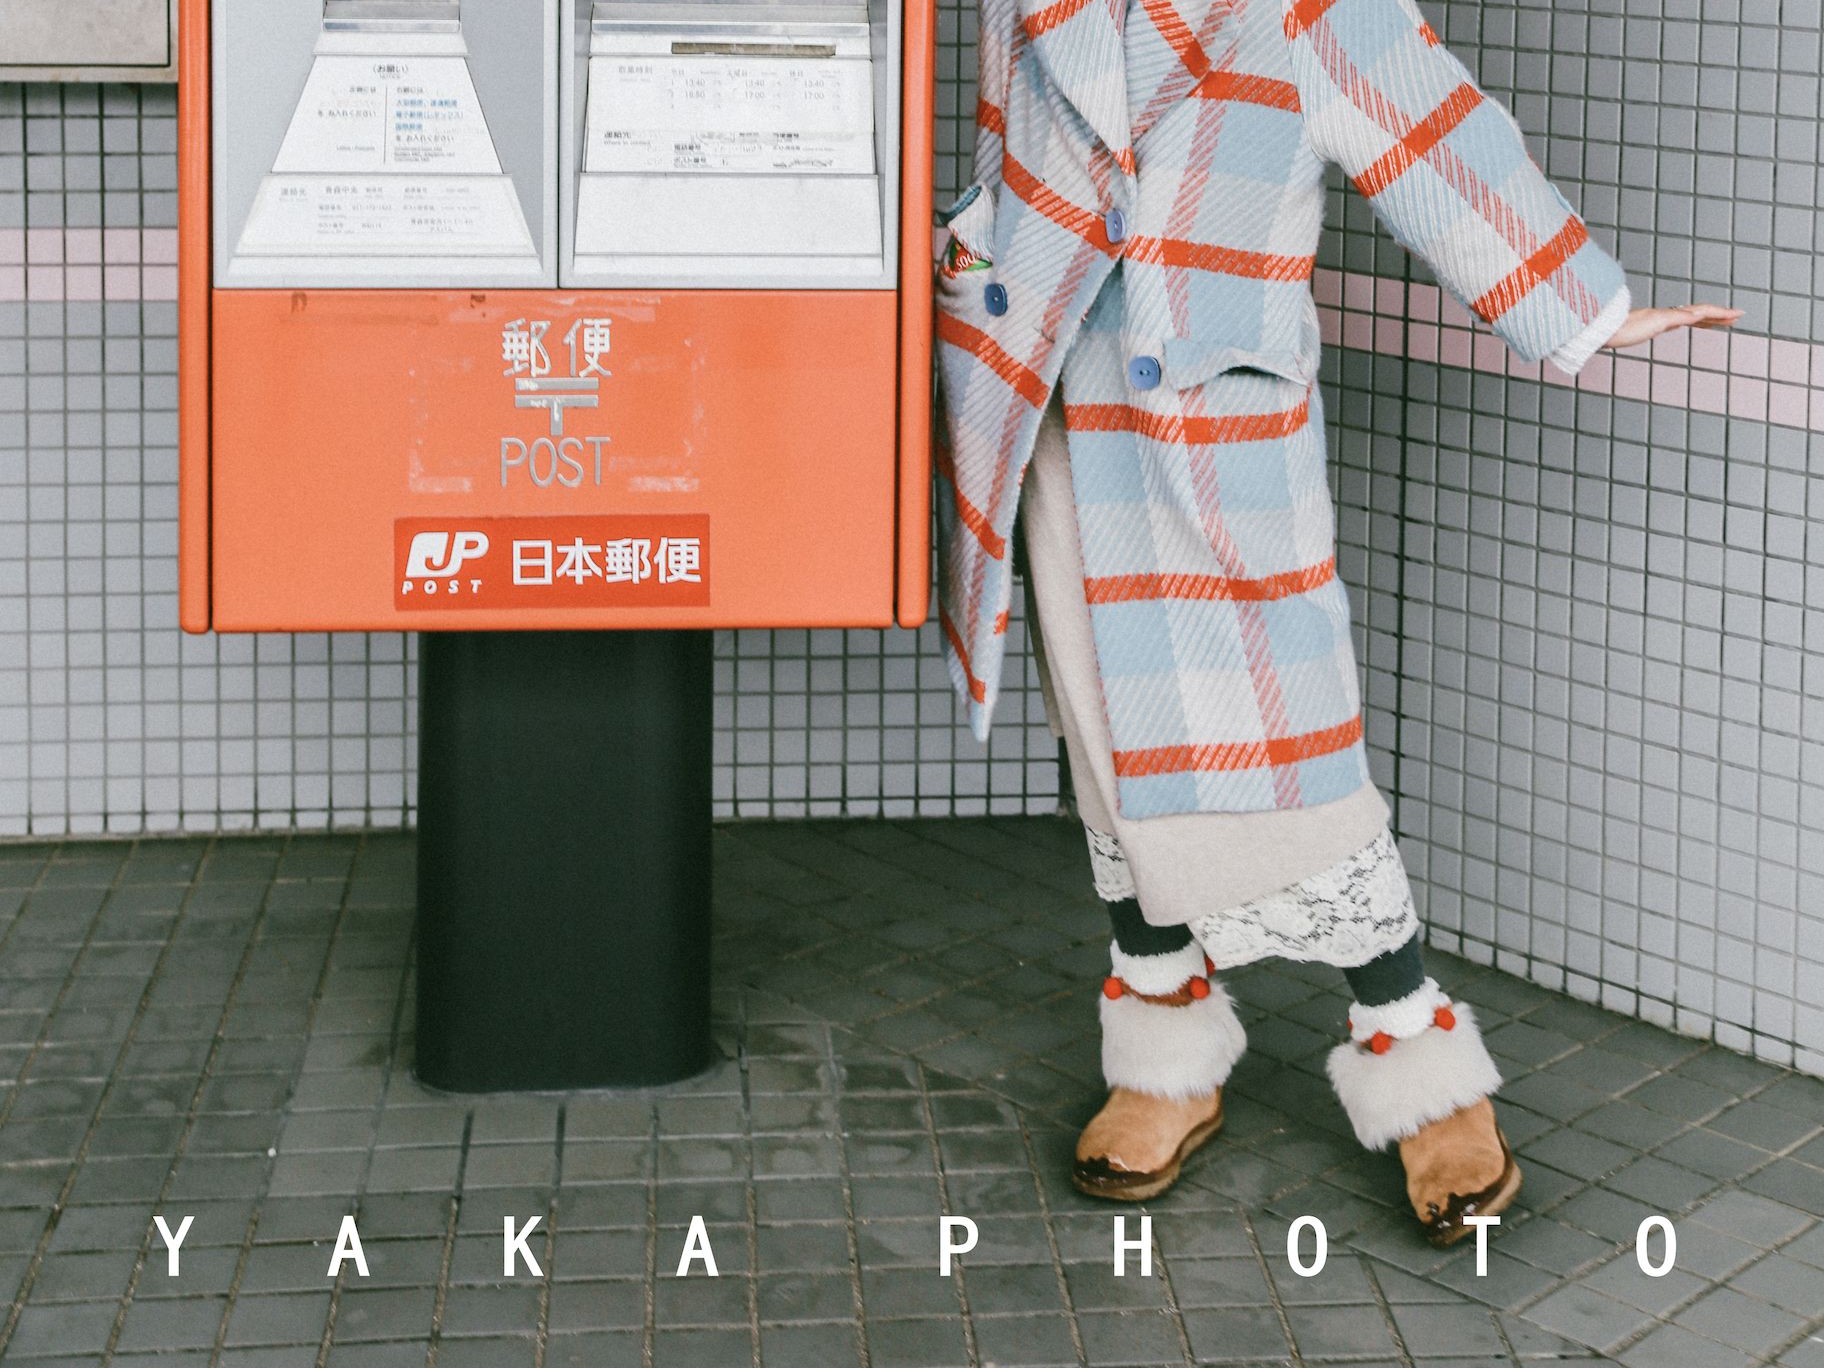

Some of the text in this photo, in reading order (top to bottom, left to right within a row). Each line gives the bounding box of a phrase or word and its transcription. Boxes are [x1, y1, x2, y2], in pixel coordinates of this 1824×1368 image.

[501, 317, 613, 378] 郵便
[500, 436, 612, 488] POST
[405, 531, 490, 578] JP
[512, 536, 702, 586] 日本郵便
[401, 579, 483, 595] POST
